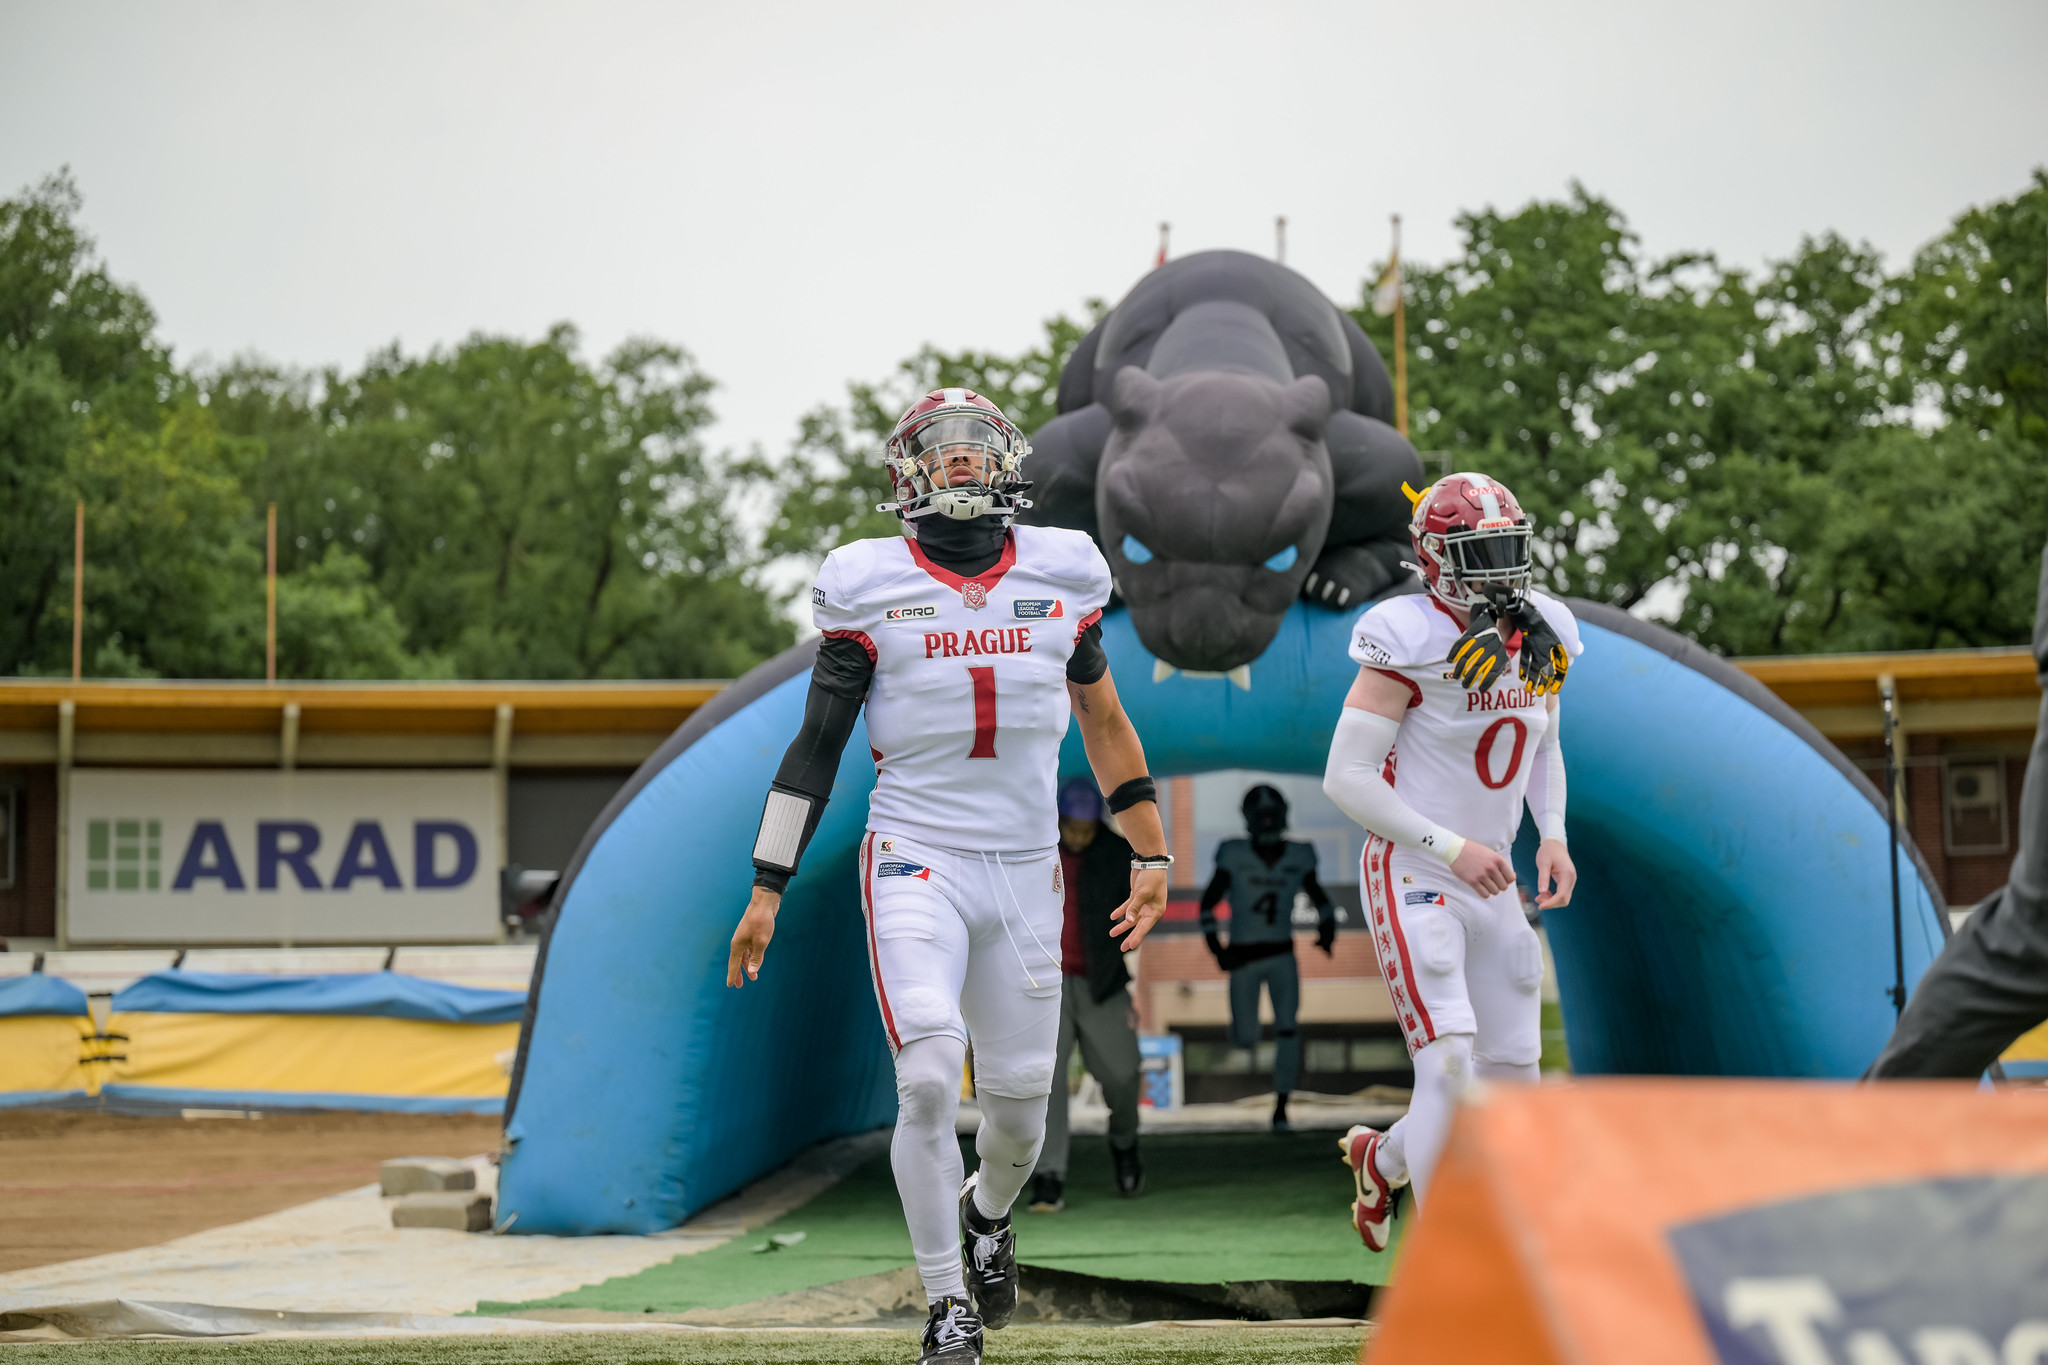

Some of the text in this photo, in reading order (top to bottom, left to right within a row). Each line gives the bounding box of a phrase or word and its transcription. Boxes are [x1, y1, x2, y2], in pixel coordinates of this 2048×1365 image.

[1481, 520, 1511, 529] FORELLE
[923, 627, 1033, 659] PRAGUE
[966, 665, 998, 759] 1
[1475, 716, 1527, 789] 0
[172, 818, 479, 892] ARAD
[1253, 892, 1278, 925] 4
